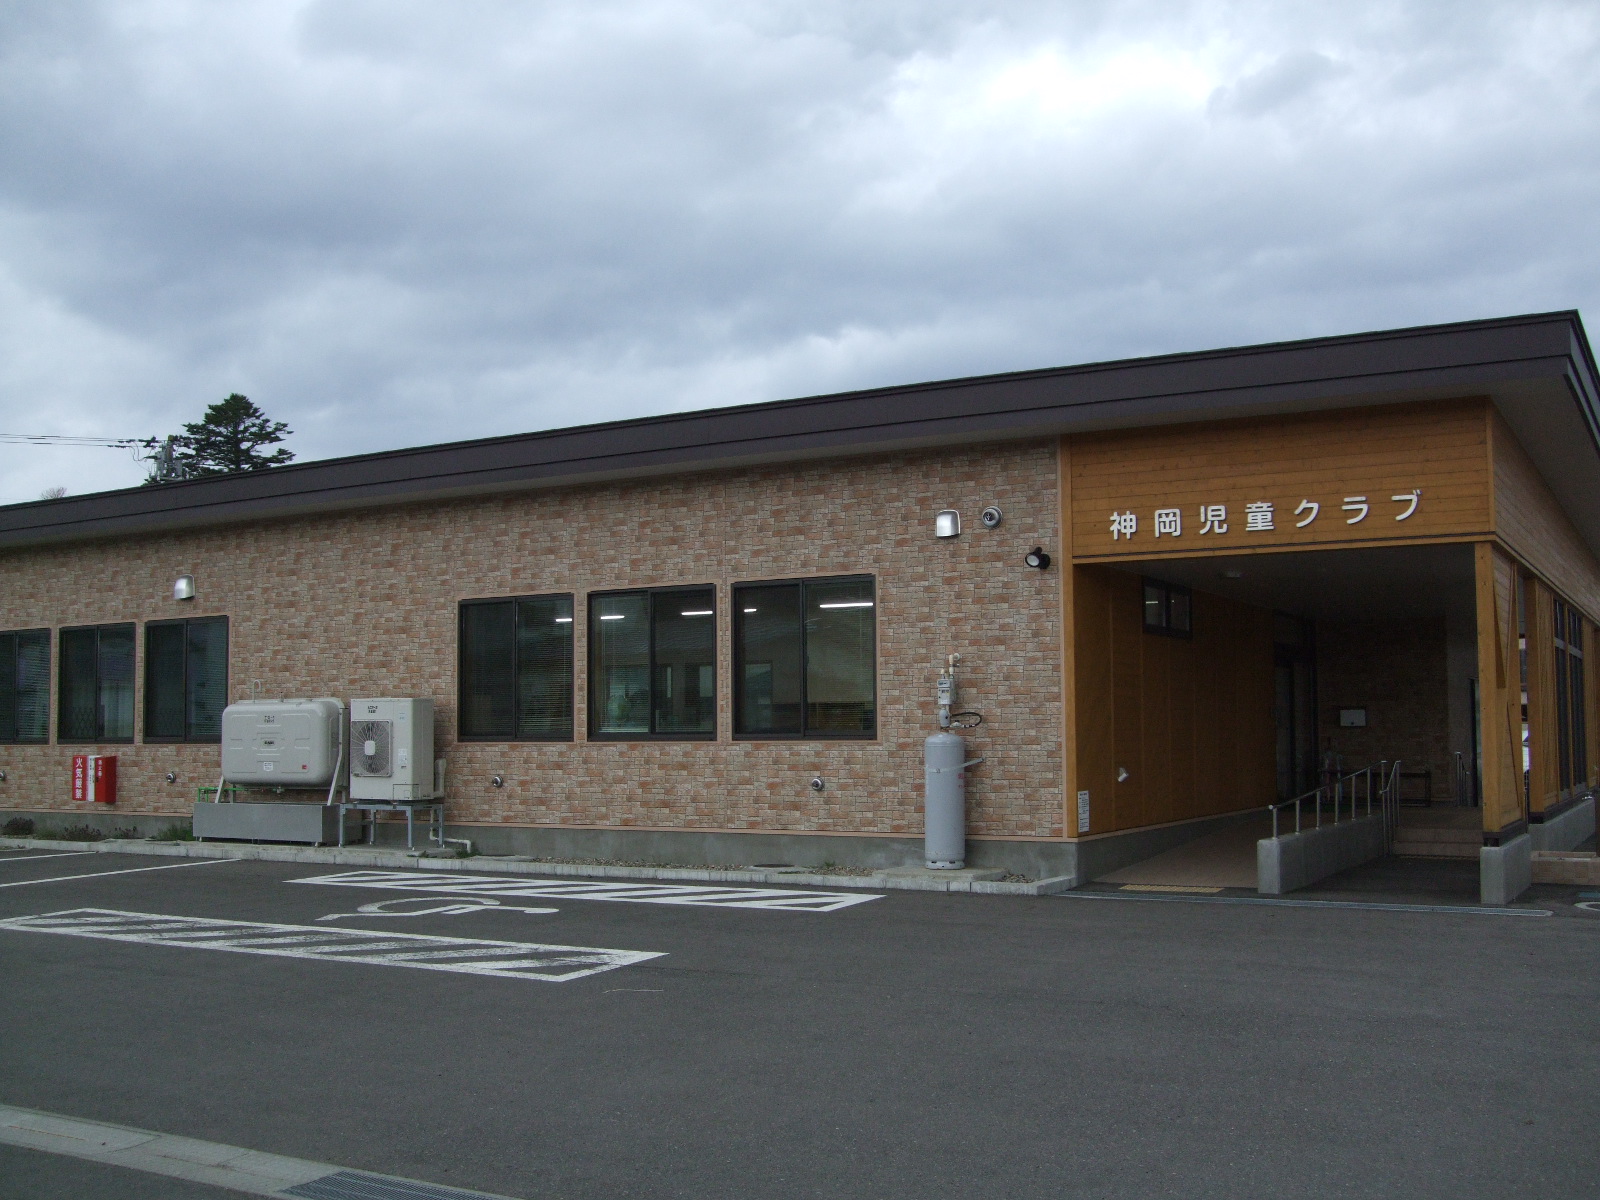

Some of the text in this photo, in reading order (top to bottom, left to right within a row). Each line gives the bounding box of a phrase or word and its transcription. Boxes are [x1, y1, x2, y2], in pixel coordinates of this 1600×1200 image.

[1109, 489, 1422, 540] 神岡児童クラブ
